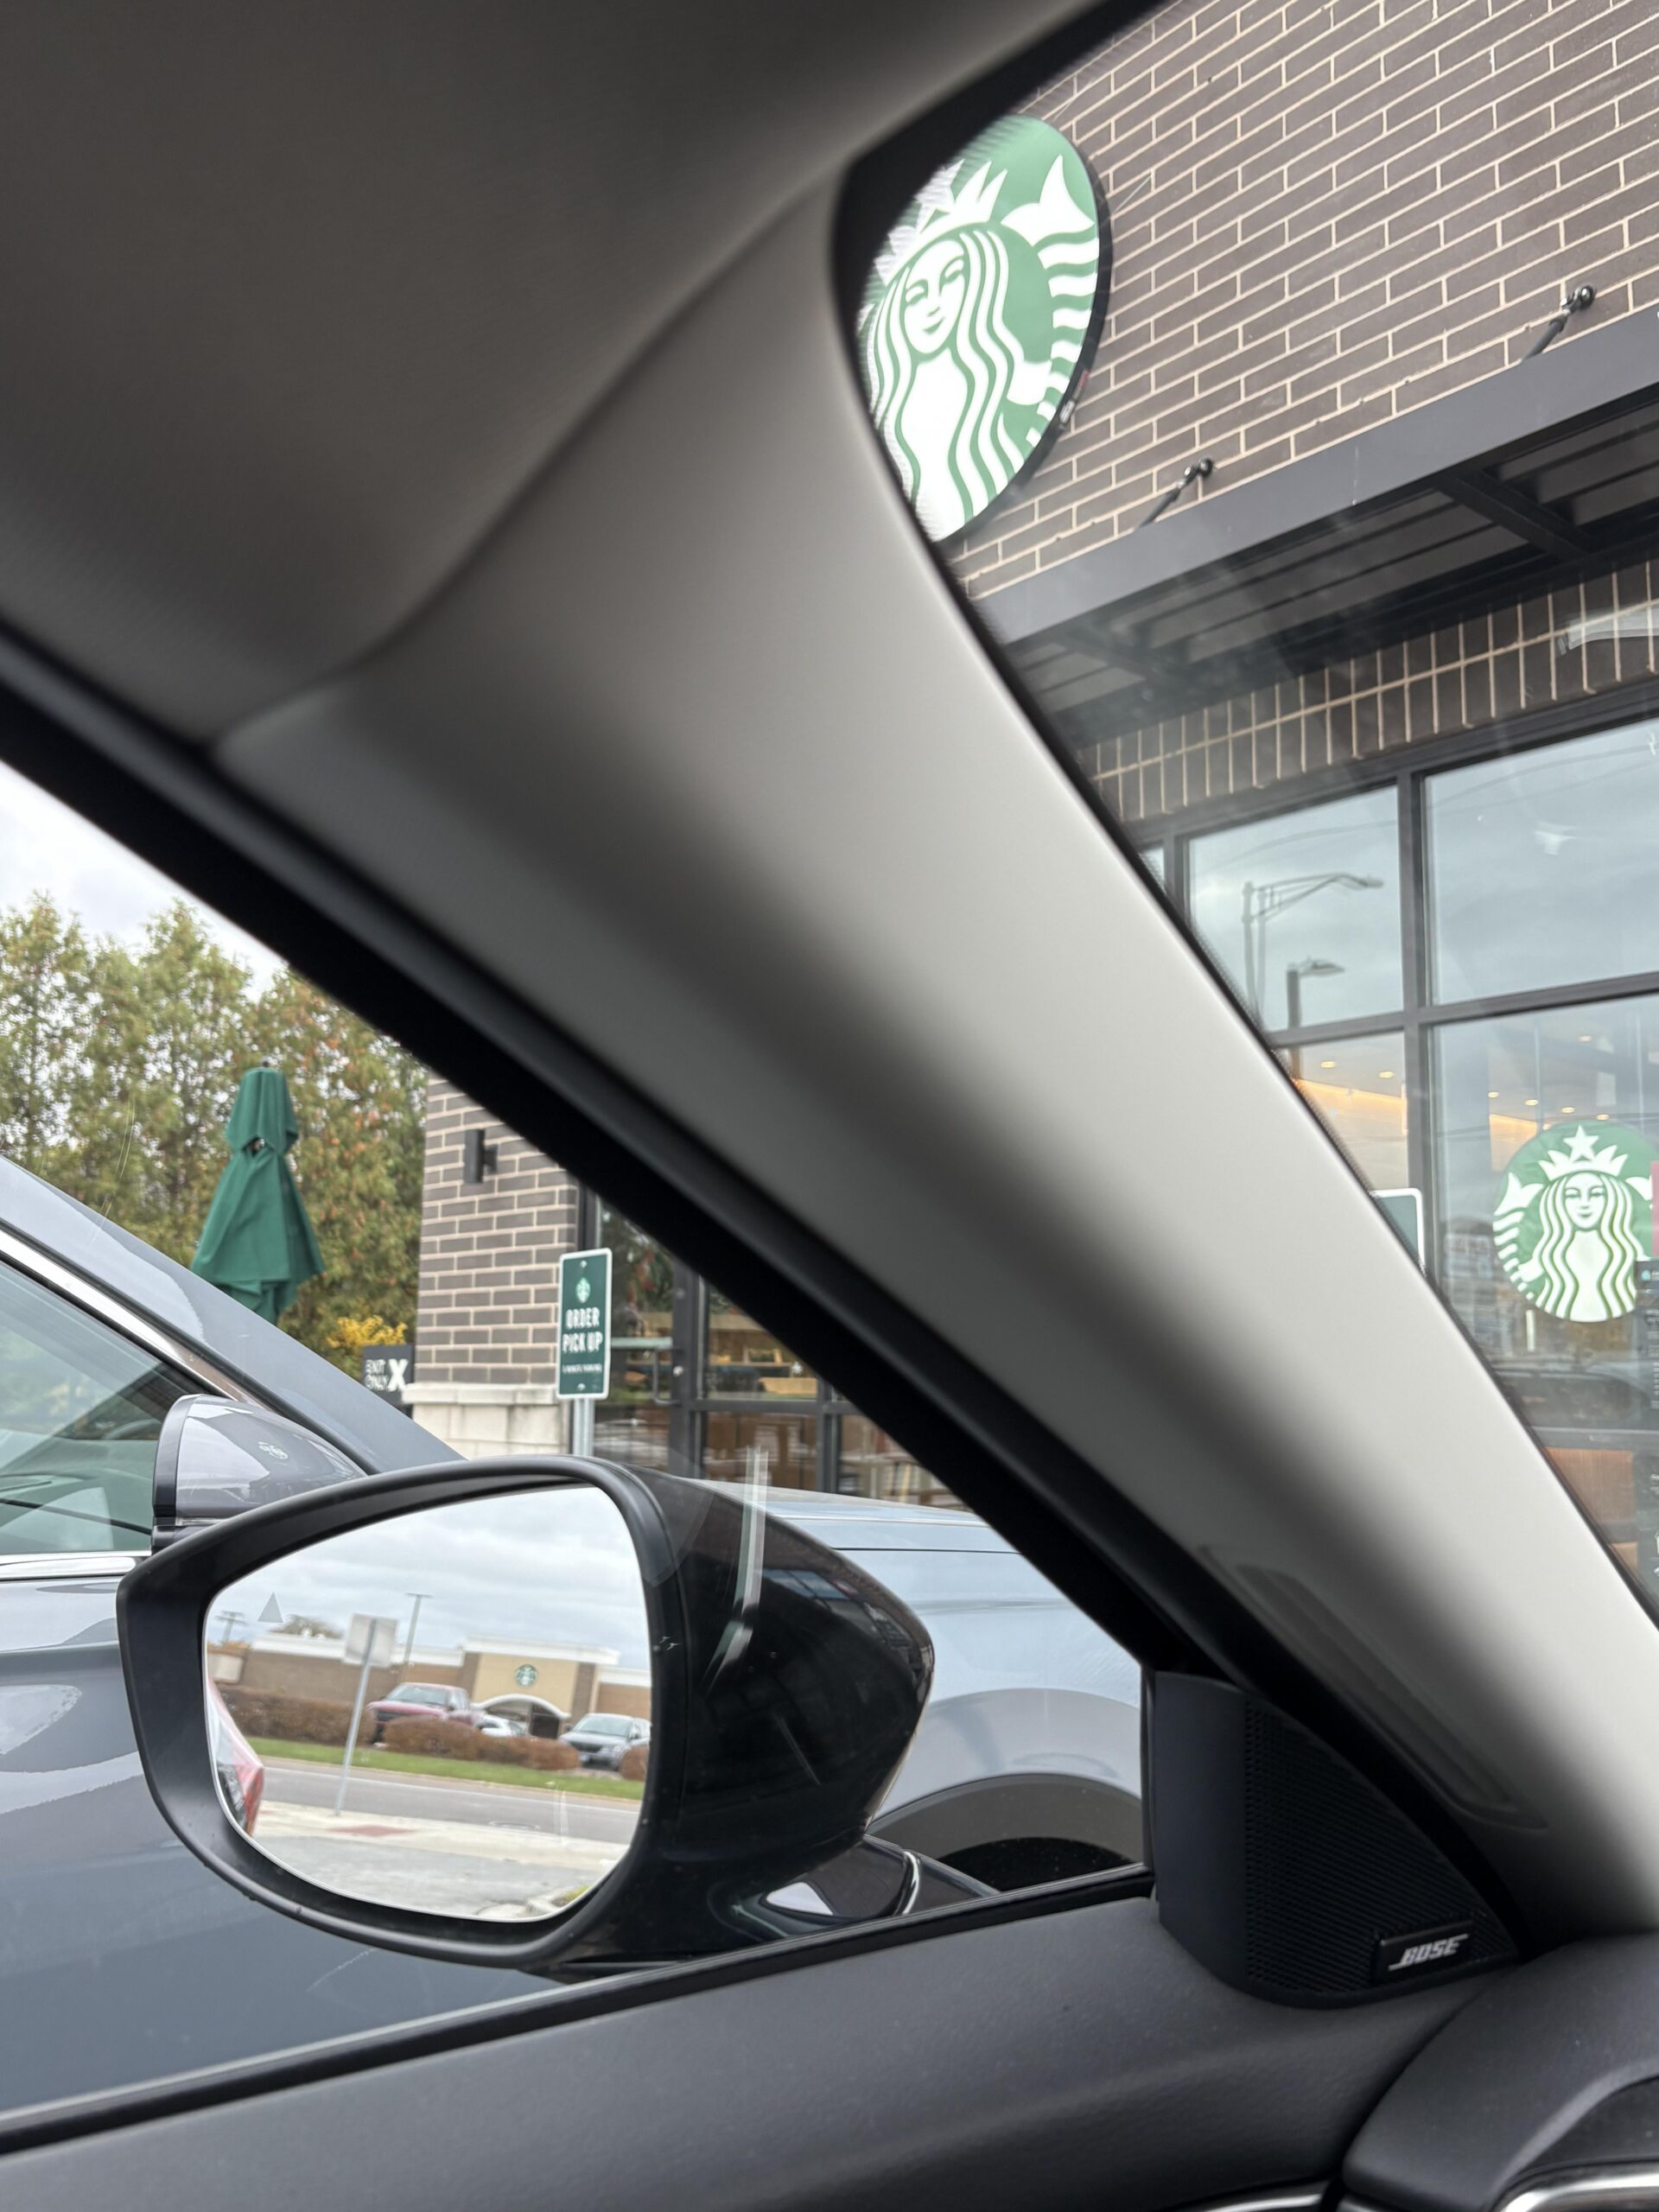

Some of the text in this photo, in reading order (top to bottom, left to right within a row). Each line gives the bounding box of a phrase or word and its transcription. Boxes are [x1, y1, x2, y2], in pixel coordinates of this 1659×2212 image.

[566, 1306, 600, 1329] ORDER
[562, 1332, 603, 1353] PICK UP
[1388, 1933, 1468, 1971] BOSE
